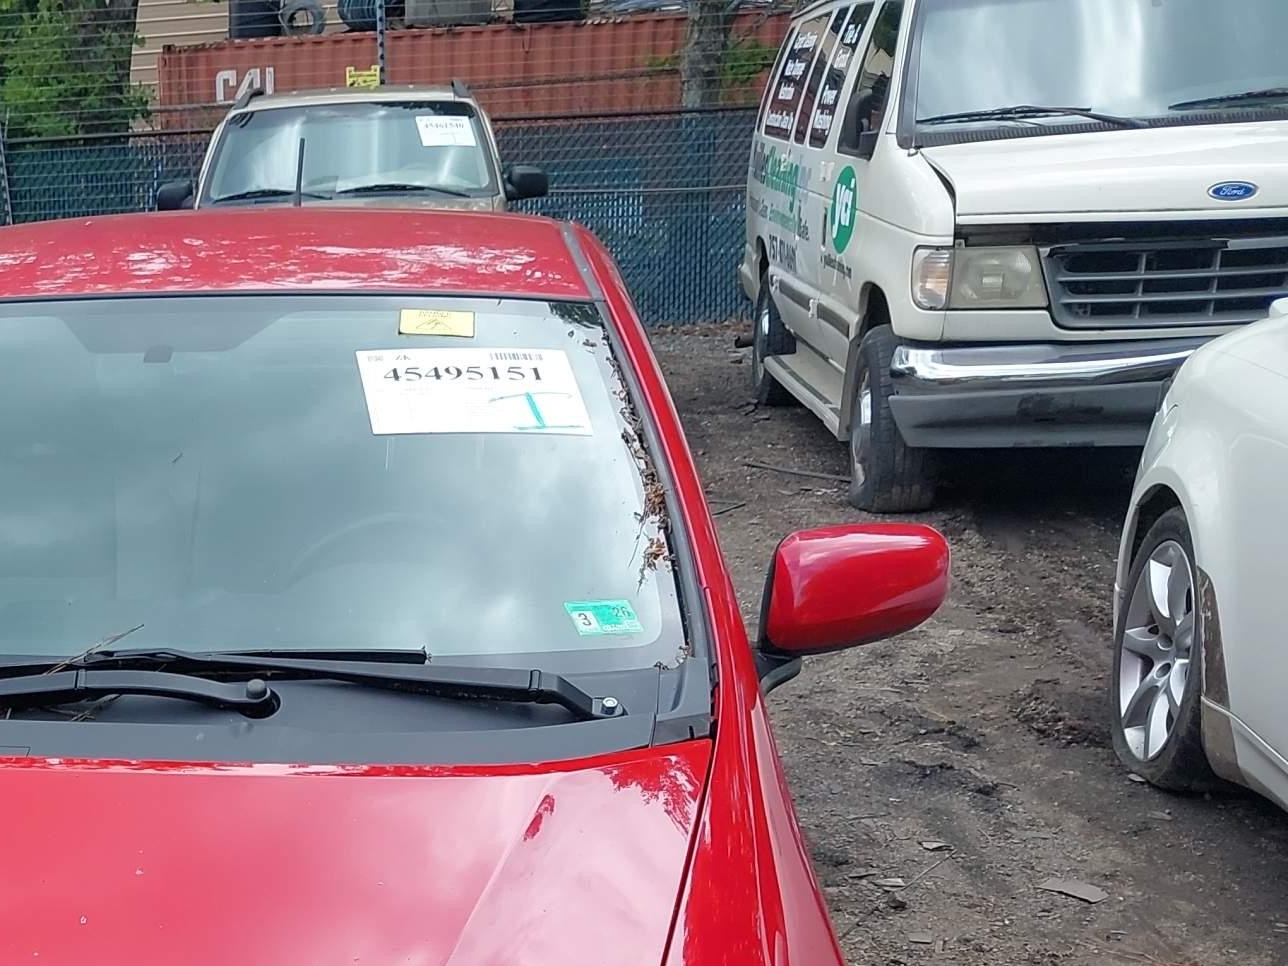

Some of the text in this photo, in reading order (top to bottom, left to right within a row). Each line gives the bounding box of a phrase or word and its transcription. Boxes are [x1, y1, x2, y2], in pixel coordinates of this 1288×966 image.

[1219, 185, 1246, 196] Ford
[383, 365, 544, 382] 45495151
[578, 612, 592, 627] 3
[612, 605, 632, 619] 26
